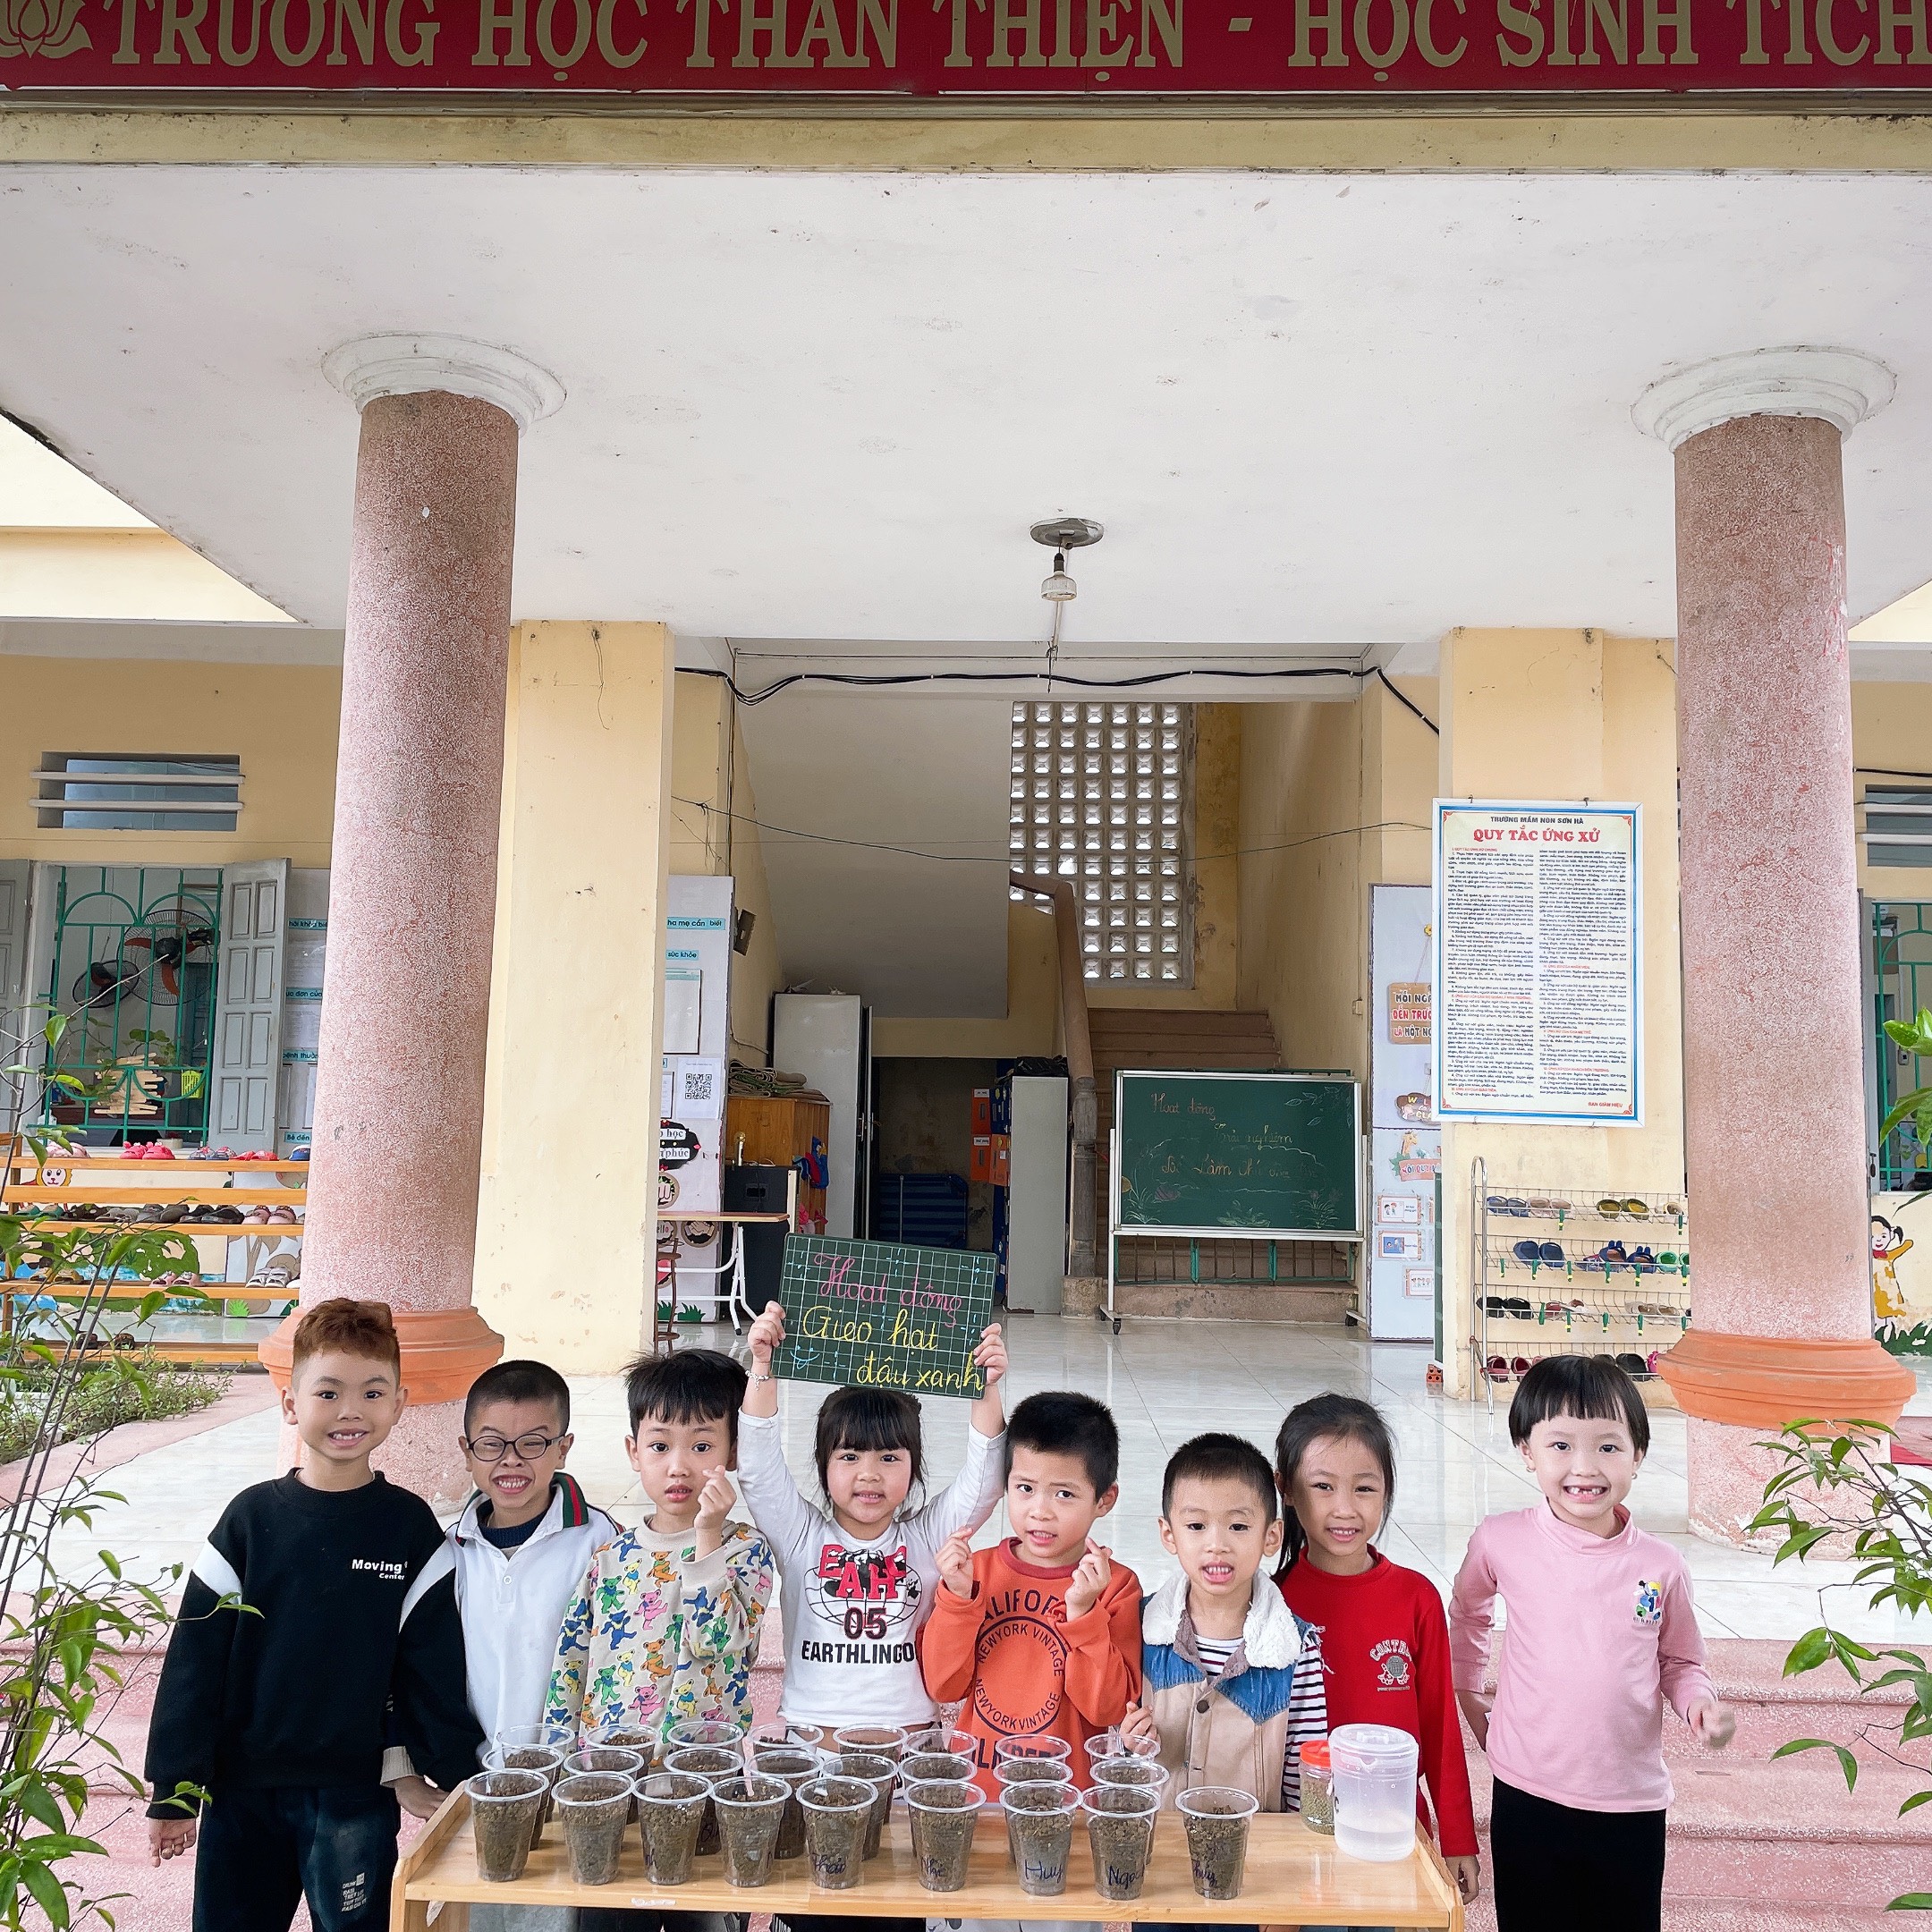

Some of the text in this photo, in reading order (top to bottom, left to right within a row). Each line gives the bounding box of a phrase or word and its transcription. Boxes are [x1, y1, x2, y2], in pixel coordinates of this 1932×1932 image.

[471, 0, 648, 81] HỌC
[1288, 0, 1469, 81] HỌC
[1496, 0, 1699, 67] SINH
[1473, 824, 1601, 843] QUY TẮC ỨNG XỬ
[666, 1128, 683, 1140] học
[813, 1252, 962, 1328] Hoạt động
[802, 1305, 938, 1355] Gieo hạt
[856, 1350, 984, 1392] đậu xanh
[352, 1559, 402, 1575] Moving
[378, 1572, 405, 1580] Center
[843, 1606, 887, 1640] 05
[801, 1640, 915, 1665] EARTHLINGO
